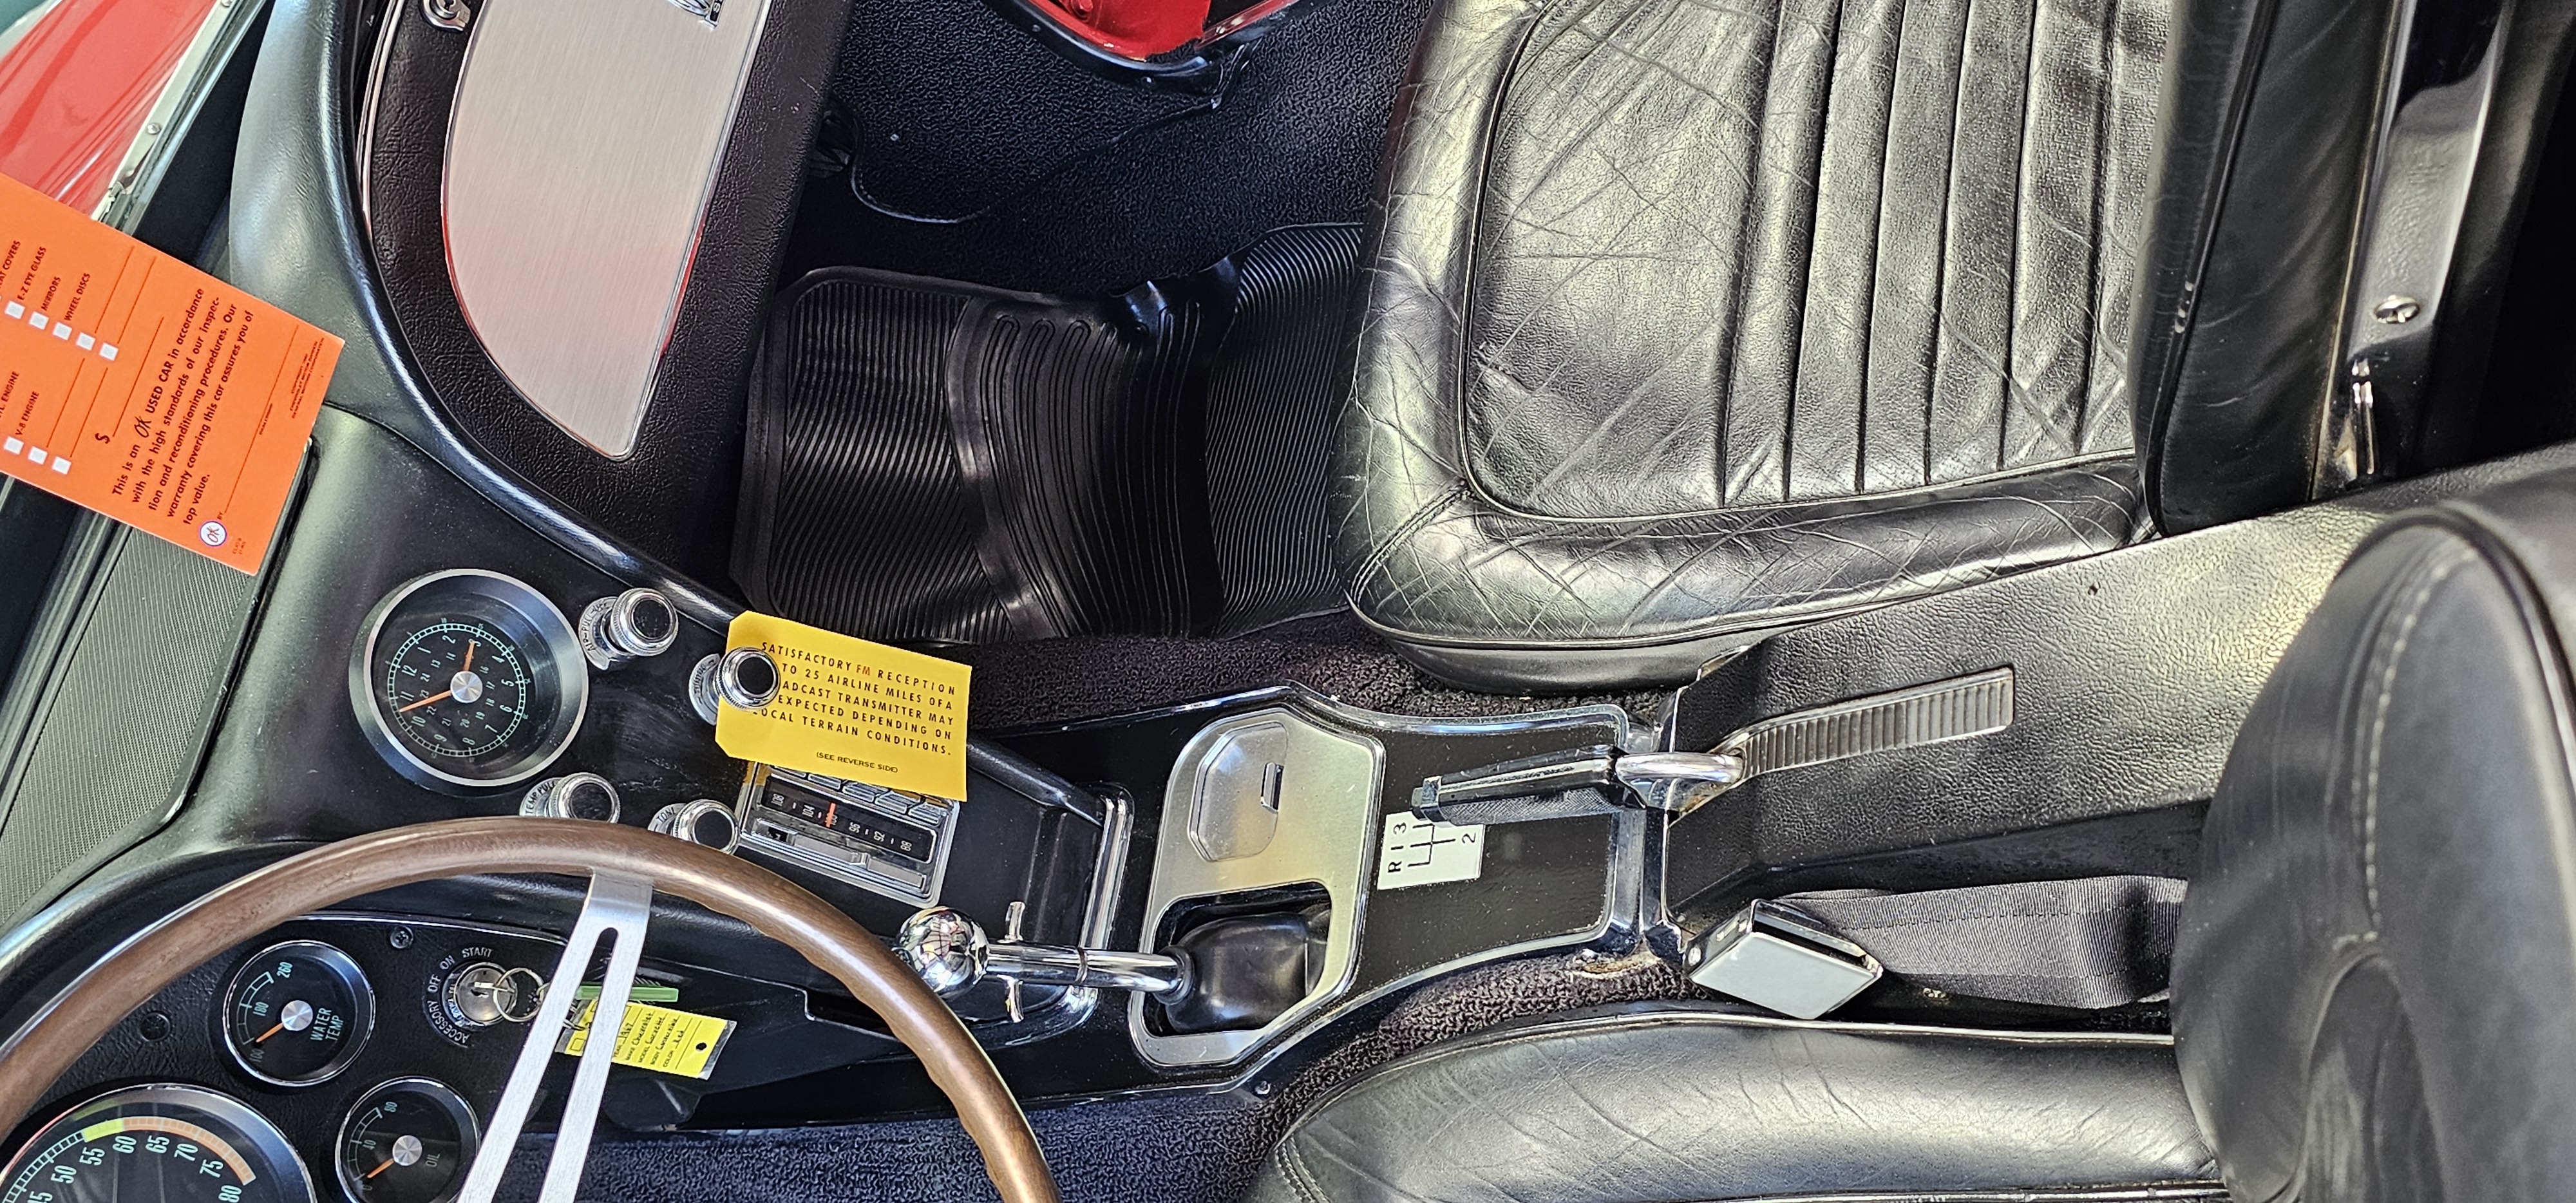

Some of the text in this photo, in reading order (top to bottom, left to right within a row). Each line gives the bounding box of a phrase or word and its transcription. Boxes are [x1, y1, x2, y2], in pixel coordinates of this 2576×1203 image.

[2, 240, 21, 270] COVERS
[24, 271, 35, 286] EYE
[30, 246, 47, 272] GLASS
[41, 276, 61, 312] MIRRORS
[64, 272, 91, 321] WHEEL DISCS
[1, 371, 19, 403] ENGINE
[111, 289, 204, 495] This is an OK USED CAR in accordance
[21, 390, 39, 422] ENGINE
[131, 297, 220, 503] with the high standards of our inspec-
[148, 303, 237, 511] tion and reconditioning procedures. Our
[167, 310, 254, 517] warranty covering this car assures you of
[183, 474, 211, 525] top value.
[442, 635, 456, 644] 2
[430, 659, 440, 668] 13
[491, 655, 505, 663] 4
[401, 665, 417, 676] 12
[762, 641, 955, 696] SATISFACTORY FM RECEPTION
[486, 681, 496, 690] 17
[500, 679, 515, 687] 5
[782, 663, 797, 675] TO
[805, 668, 819, 680] 25
[827, 674, 879, 694] AIRLINE
[886, 687, 922, 703] MILES
[400, 690, 415, 701] 11
[485, 697, 495, 706] 18
[782, 680, 954, 726] ADCAST TRANSMITTER MAY
[426, 705, 437, 715] 22
[475, 711, 485, 720] 19
[499, 705, 513, 713] 6
[777, 694, 951, 740] EXPECTED DEPENDING ON
[411, 715, 426, 727] 10
[460, 718, 470, 728] 20
[484, 724, 498, 733] 7
[433, 734, 447, 742] 9
[753, 708, 951, 755] OCAL TERRAIN CONDITIONS.
[816, 752, 898, 773] (SEE REVERSE SIDE)
[802, 804, 815, 818] 104
[848, 822, 861, 833] 96
[873, 830, 886, 842] 92
[1393, 822, 1407, 835] 3
[900, 840, 913, 851] 88
[1462, 832, 1476, 844] 2
[1387, 861, 1403, 873] R
[461, 947, 494, 958] START
[276, 961, 293, 978] 260
[439, 954, 457, 970] ON
[427, 973, 441, 992] OFF
[310, 1007, 332, 1041] WATER
[325, 1015, 345, 1041] TEMP
[427, 1000, 471, 1043] ACCESSORY
[249, 1048, 265, 1063] 100
[112, 1135, 137, 1154] 60
[145, 1135, 170, 1154] 65
[173, 1143, 199, 1161] 70
[79, 1146, 105, 1166] 55
[425, 1153, 440, 1168] OIL
[50, 1165, 77, 1184] 50
[199, 1159, 224, 1178] 75
[218, 1184, 243, 1203] 80
